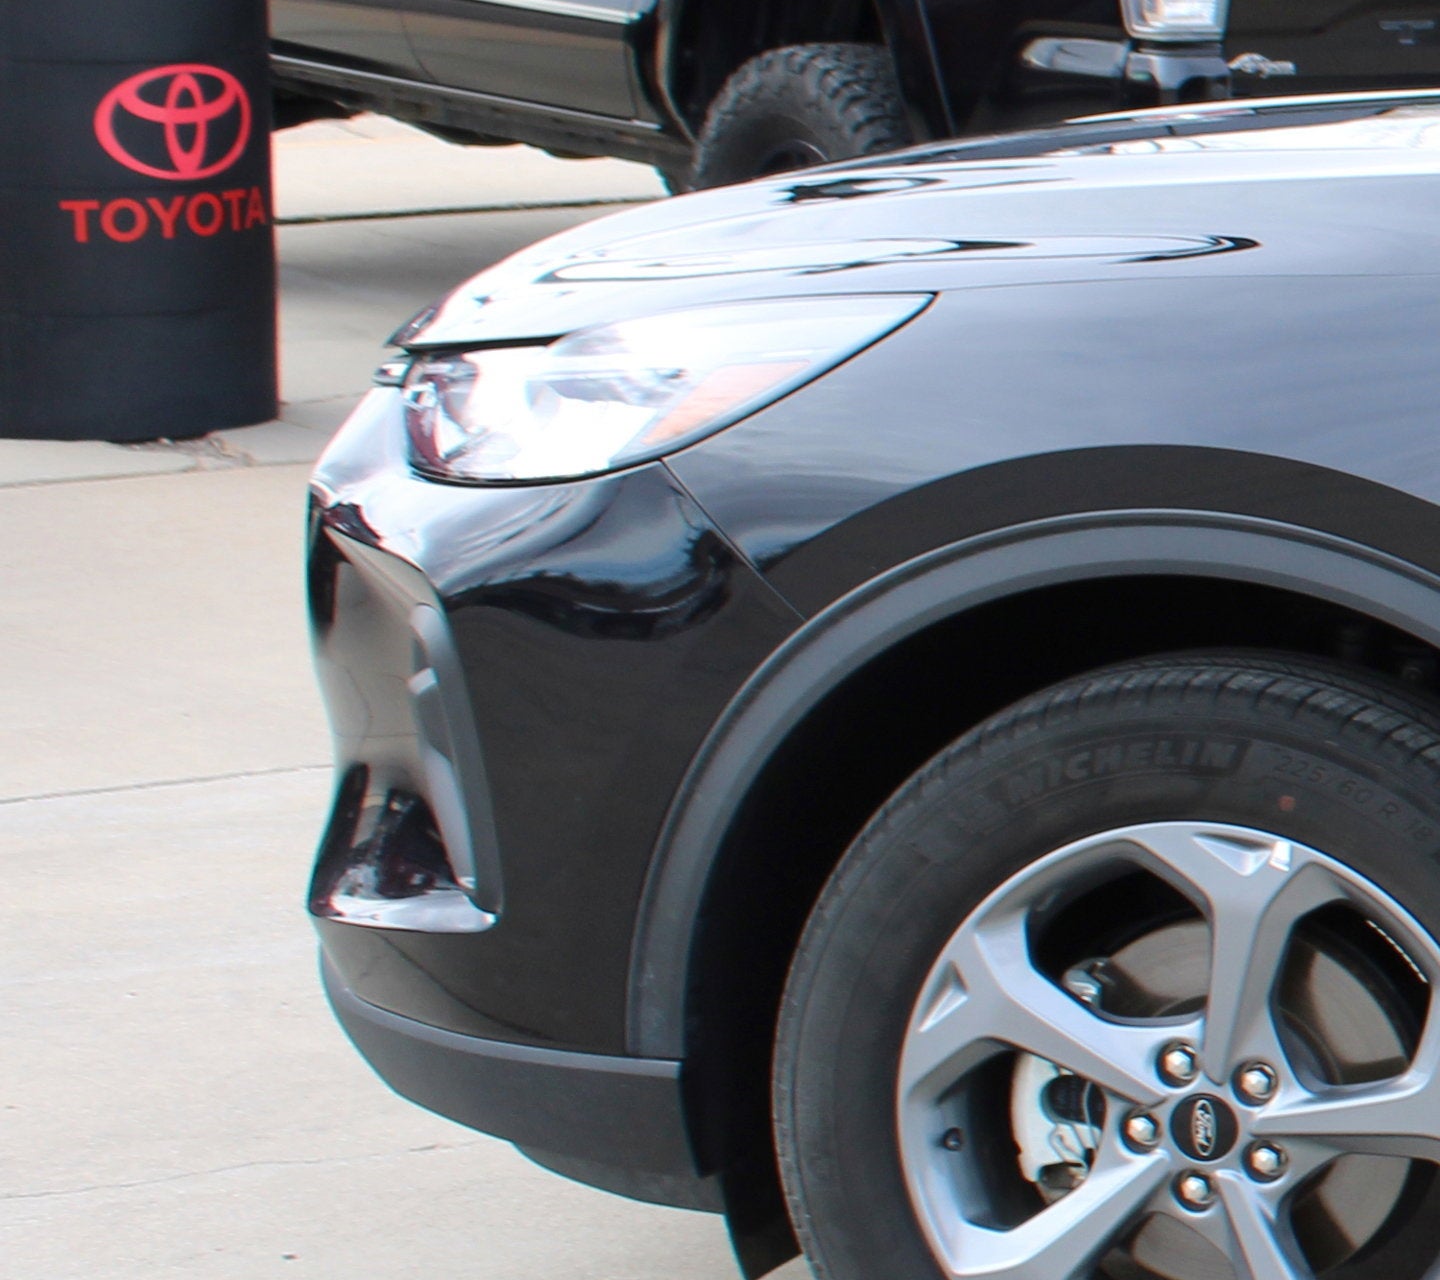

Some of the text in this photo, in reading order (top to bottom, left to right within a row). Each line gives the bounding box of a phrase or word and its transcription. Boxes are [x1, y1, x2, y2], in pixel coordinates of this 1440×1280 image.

[58, 186, 266, 244] TOYOTA
[1006, 739, 1240, 805] MICHELIN
[1273, 753, 1375, 805] 225/60
[1380, 798, 1402, 819] R
